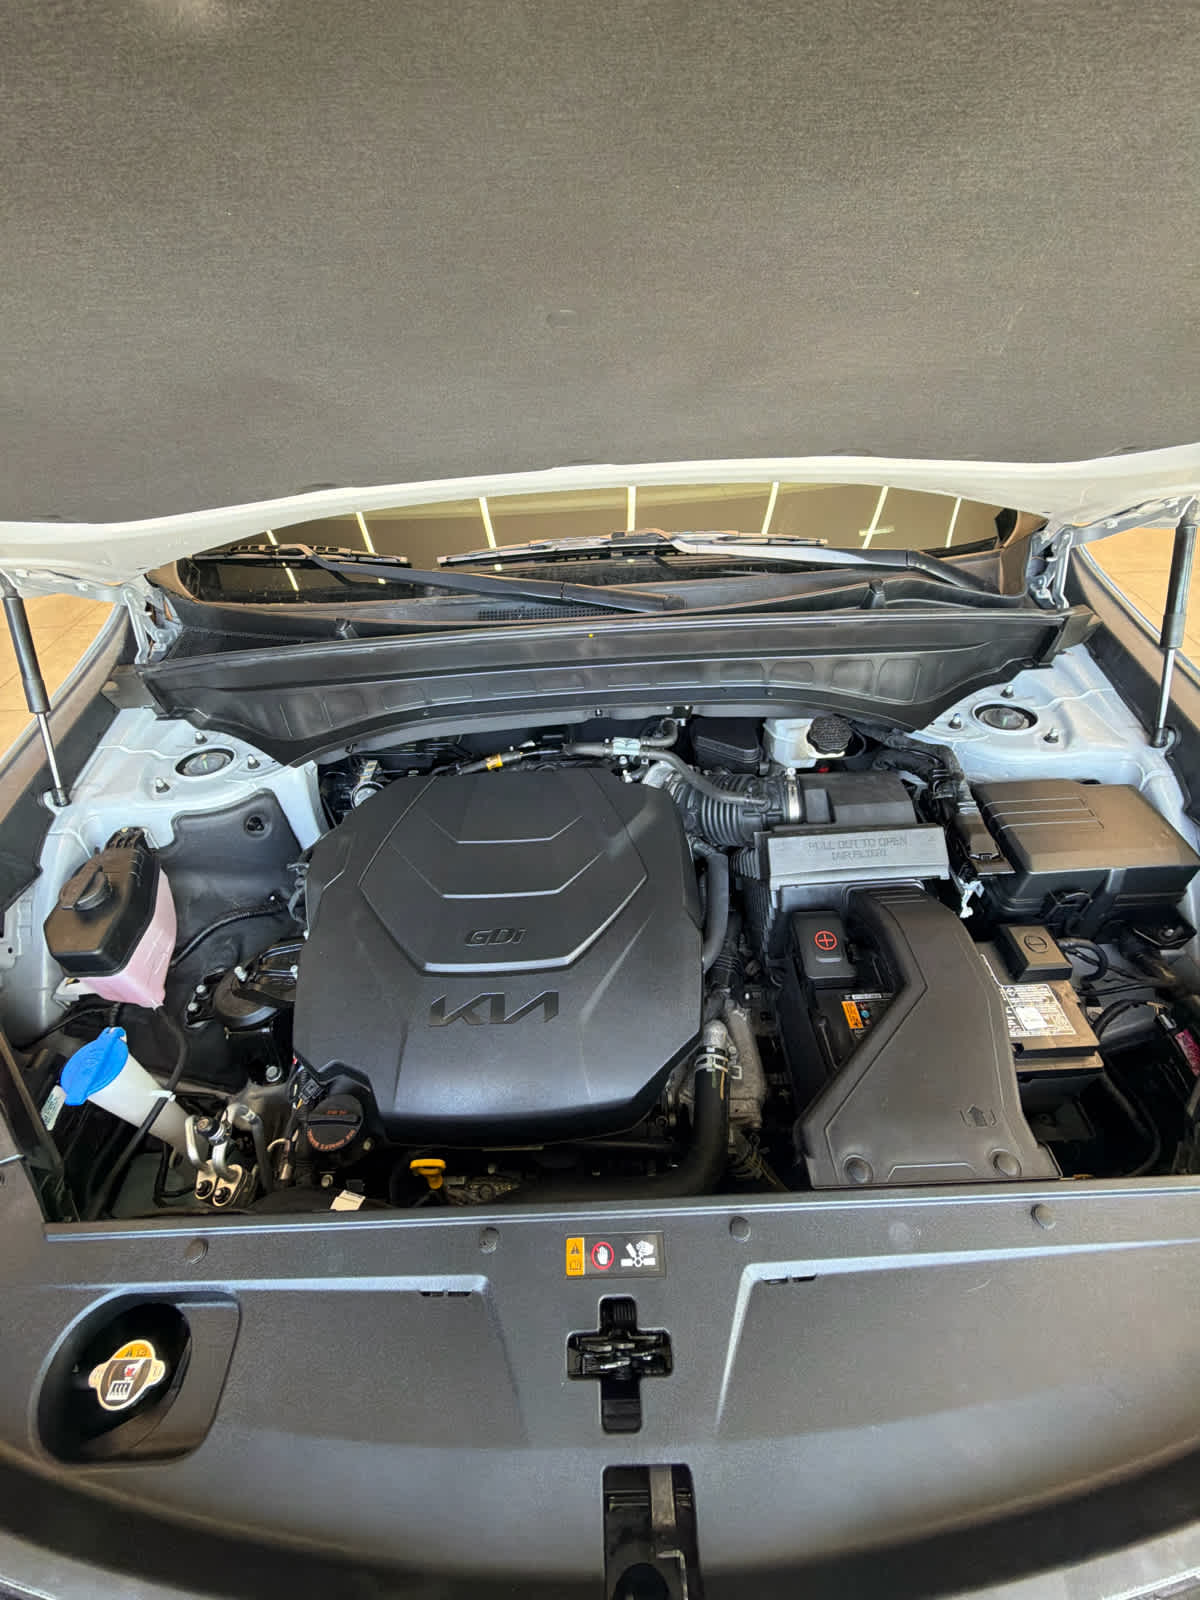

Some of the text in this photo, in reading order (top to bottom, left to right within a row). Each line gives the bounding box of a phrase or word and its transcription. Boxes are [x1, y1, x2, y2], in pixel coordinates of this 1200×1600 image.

[808, 839, 835, 850] PULL
[878, 836, 908, 847] OPEN
[428, 989, 560, 1027] KIA
